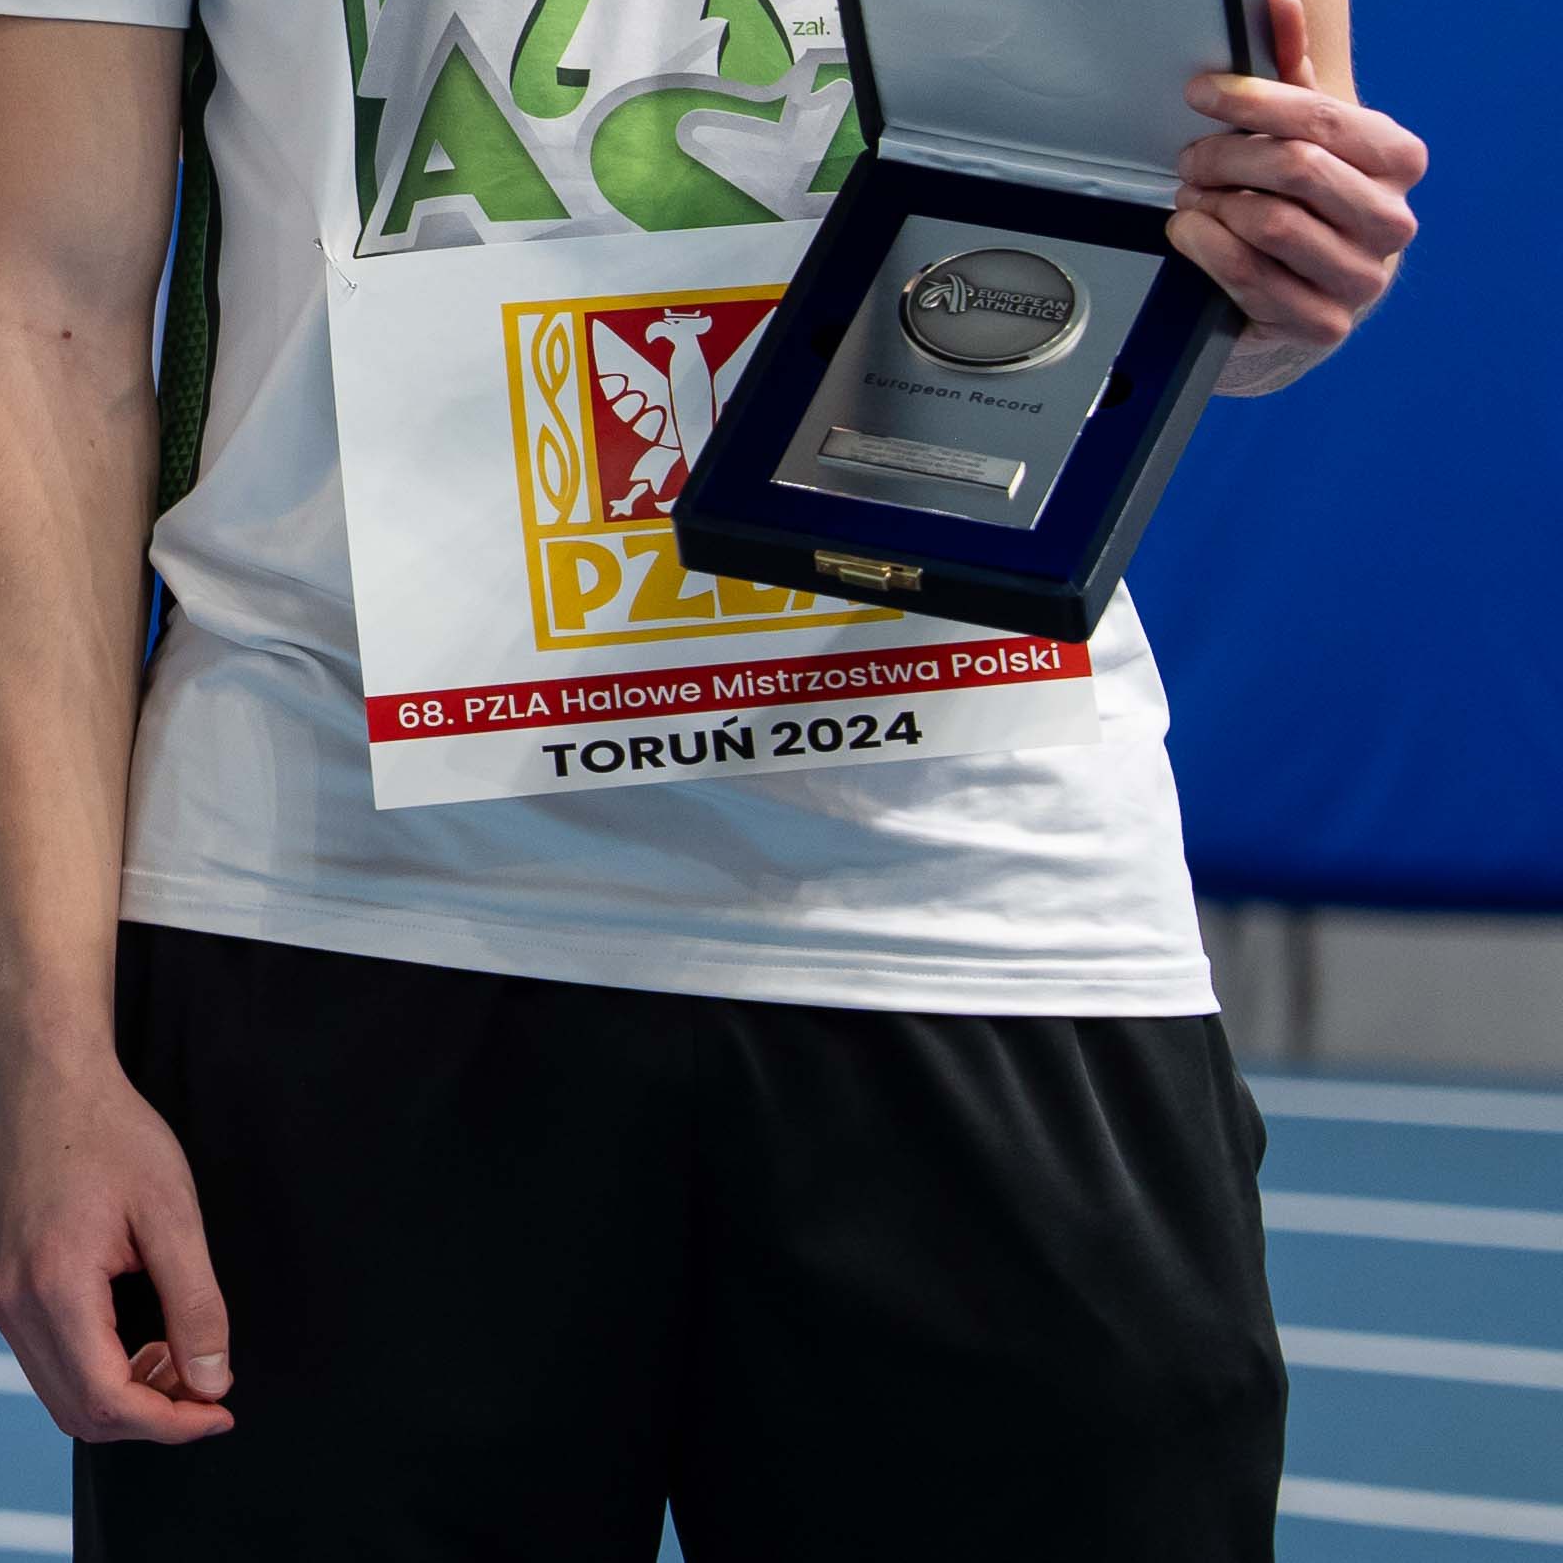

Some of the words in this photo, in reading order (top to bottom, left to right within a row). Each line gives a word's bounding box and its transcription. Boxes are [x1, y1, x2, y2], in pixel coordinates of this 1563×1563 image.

[973, 299, 1065, 321] ATHLETICS
[977, 288, 1068, 311] EUROPEAN
[863, 373, 961, 400] European
[969, 390, 1044, 414] Record
[398, 700, 453, 729] 68.
[464, 692, 550, 723] PZLA
[561, 682, 701, 715] Halowe
[713, 658, 940, 700] Mistrzostwa
[951, 642, 1061, 678] Polski
[542, 715, 756, 777] TORUŃ
[770, 710, 923, 757] 2024
